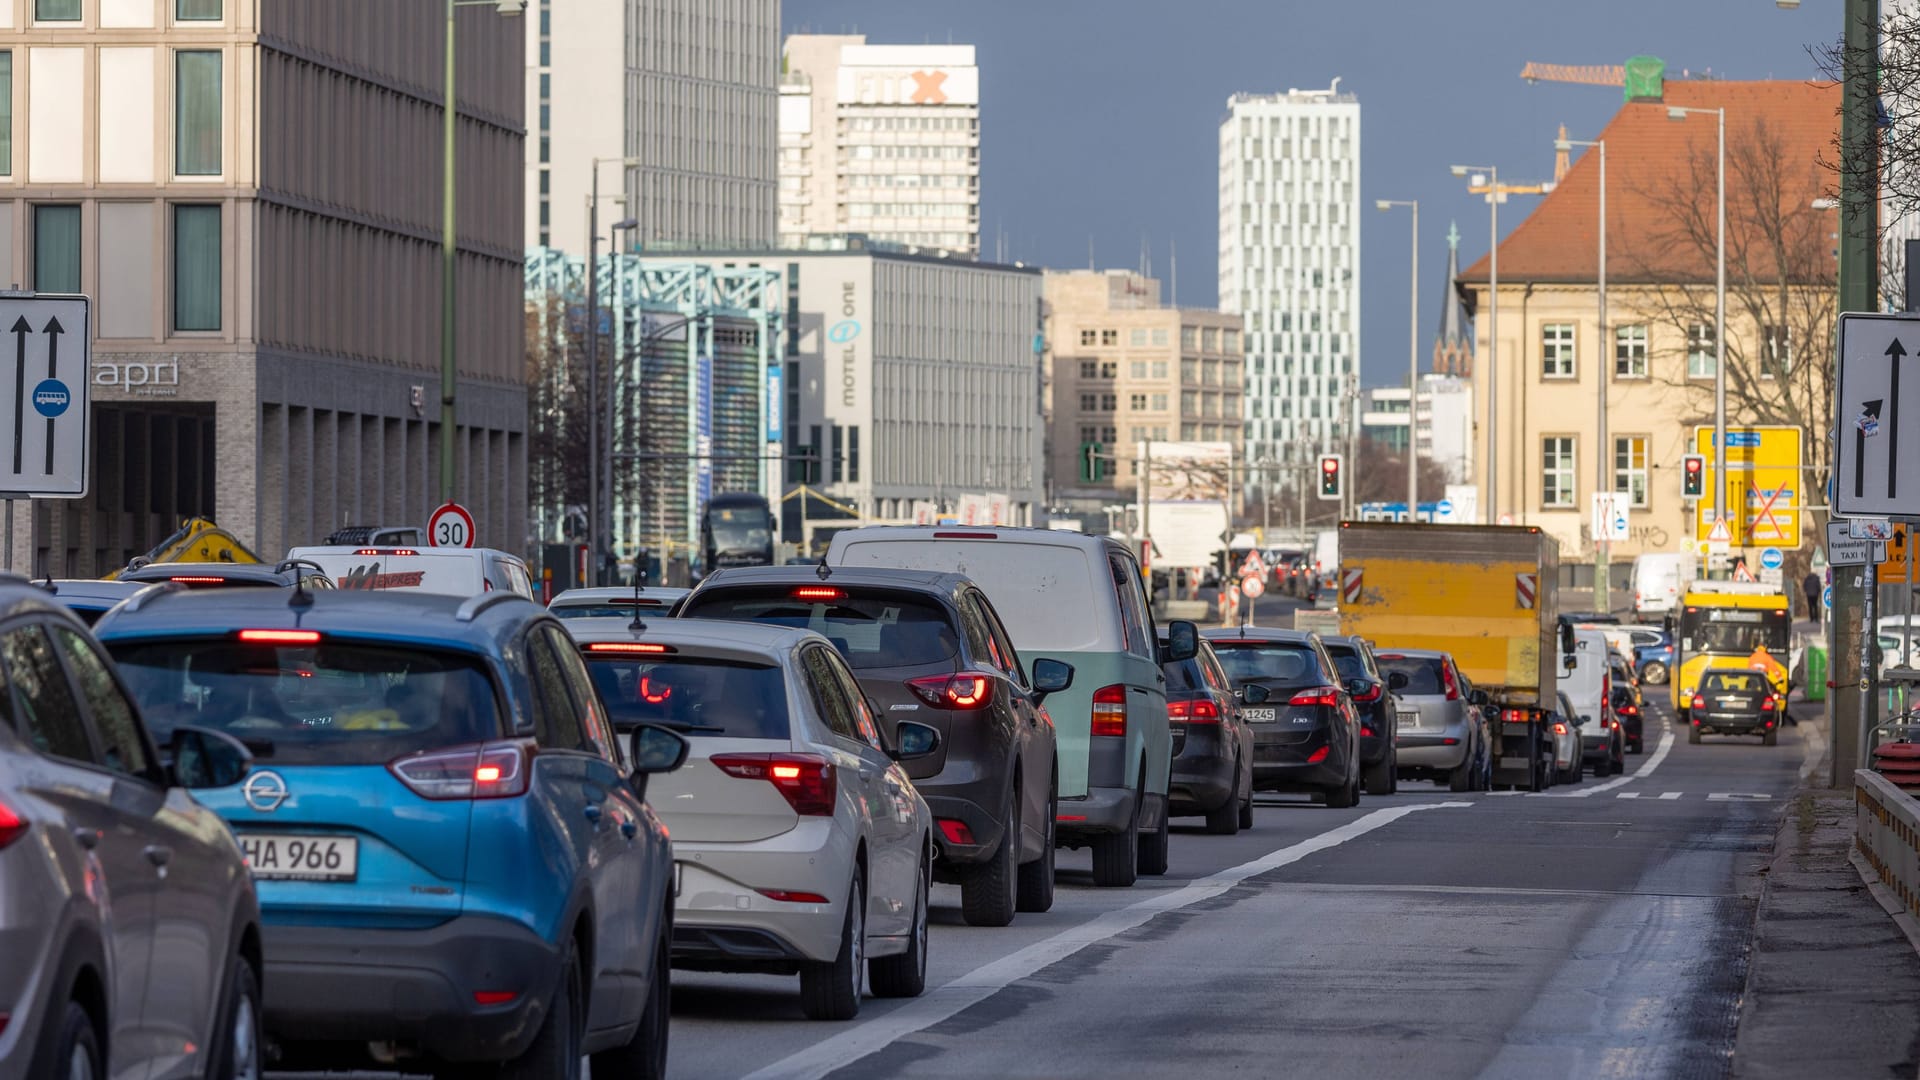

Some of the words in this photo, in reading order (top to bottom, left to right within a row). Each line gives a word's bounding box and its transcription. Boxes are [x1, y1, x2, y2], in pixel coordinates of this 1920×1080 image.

[92, 356, 179, 393] apri
[438, 522, 463, 546] 30
[1841, 552, 1858, 560] TAXI
[1247, 710, 1274, 719] 1245
[288, 841, 342, 869] 966
